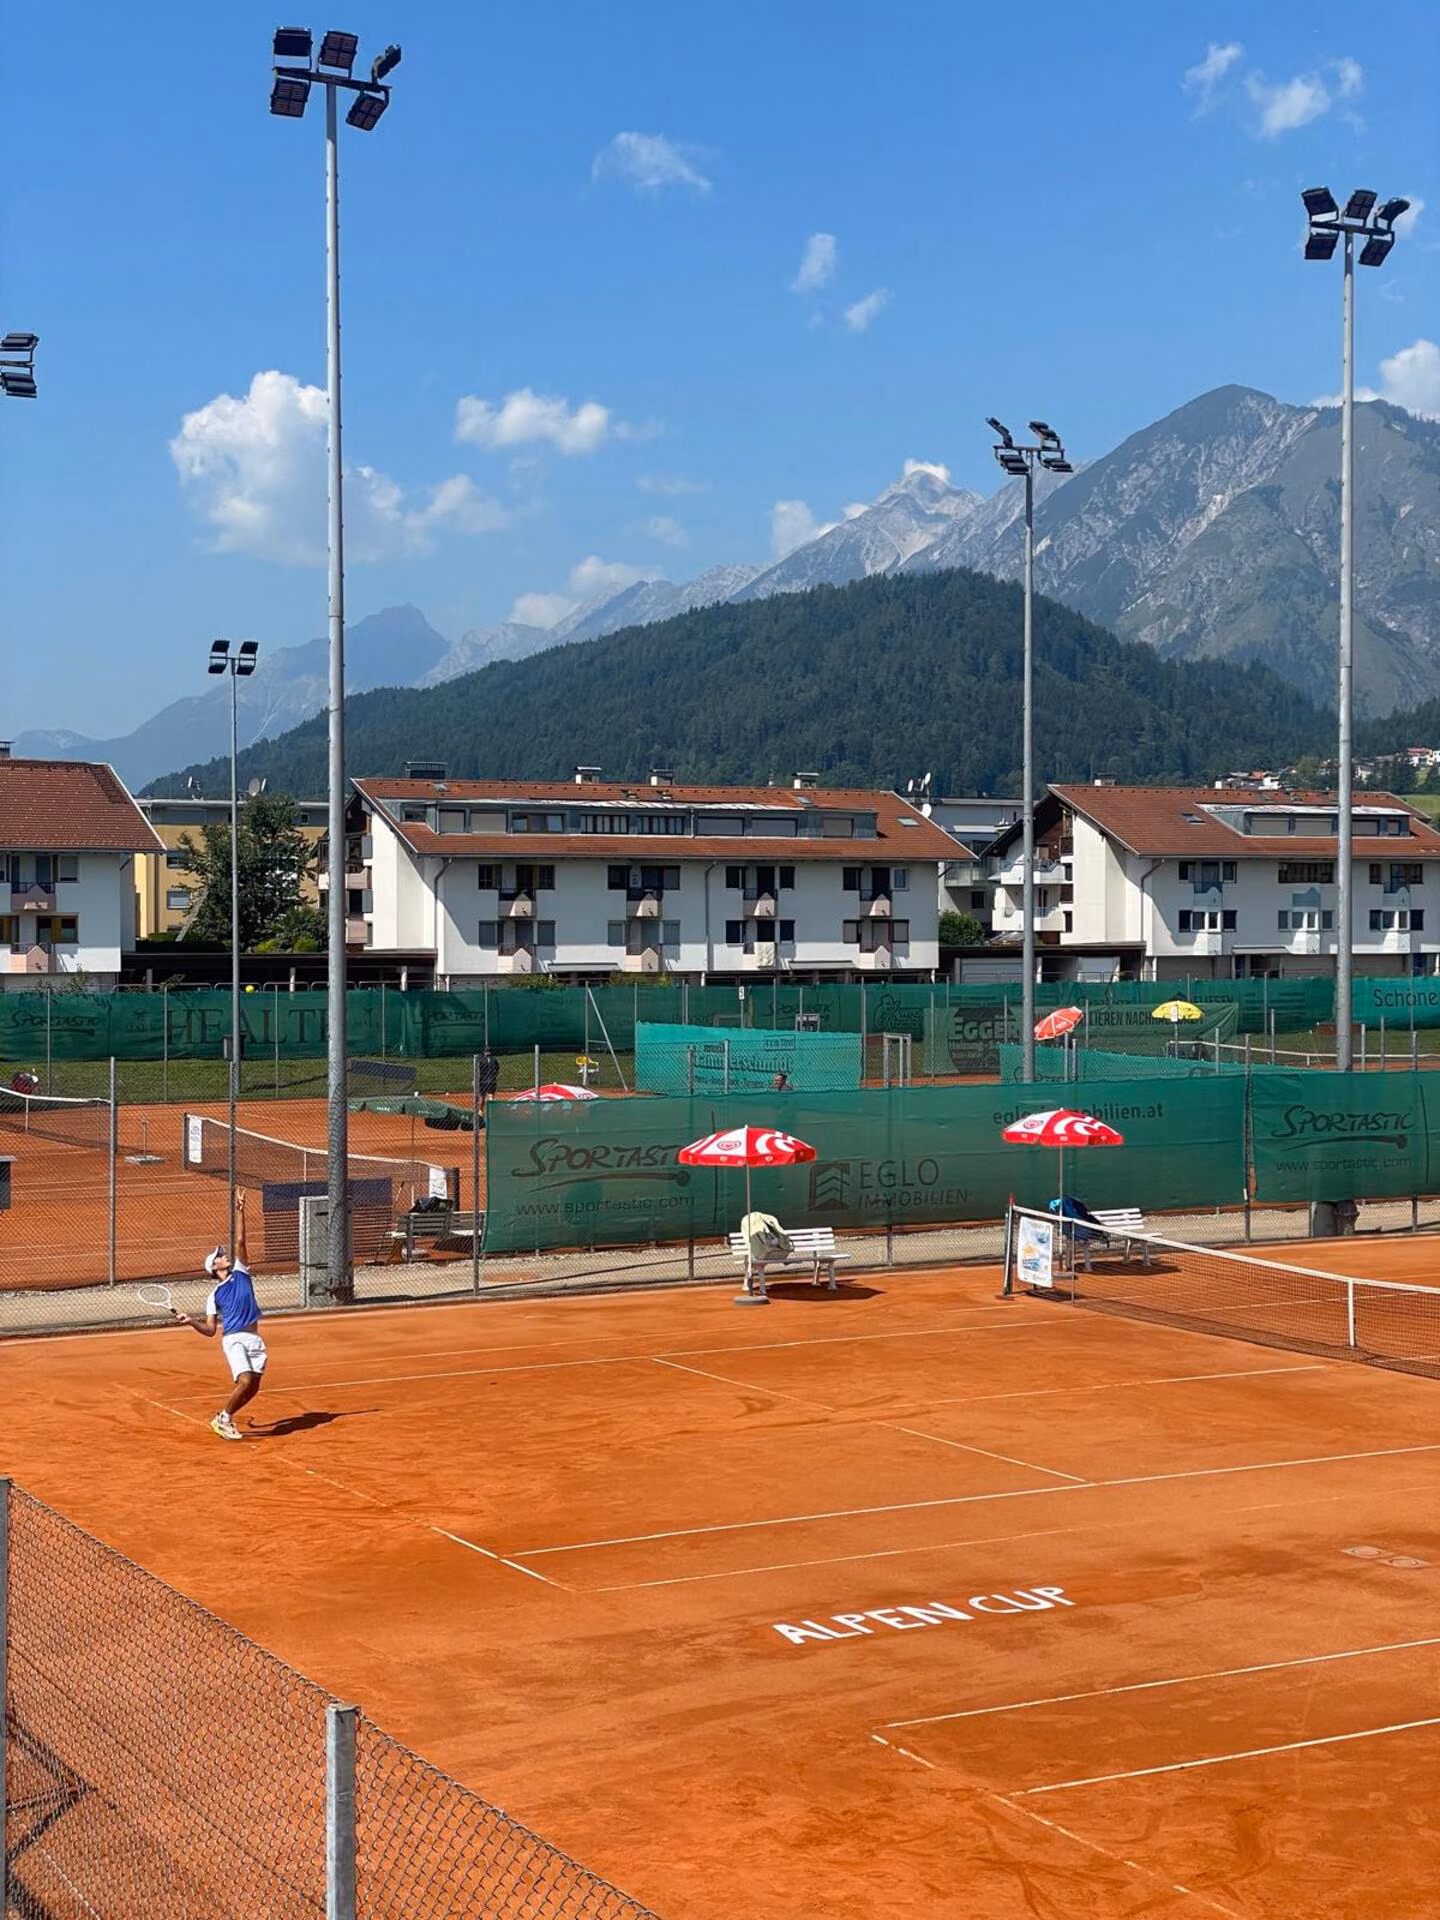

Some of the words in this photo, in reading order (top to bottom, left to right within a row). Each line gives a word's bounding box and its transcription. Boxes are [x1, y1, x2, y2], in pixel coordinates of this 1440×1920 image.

[1271, 1104, 1414, 1138] SPORTASTIC
[511, 1138, 680, 1177] SPORTASTI
[860, 1159, 939, 1189] EGLO
[859, 1188, 968, 1209] IMMOBILIEN
[772, 1602, 975, 1645] ALPEN
[968, 1586, 1077, 1614] CUP
